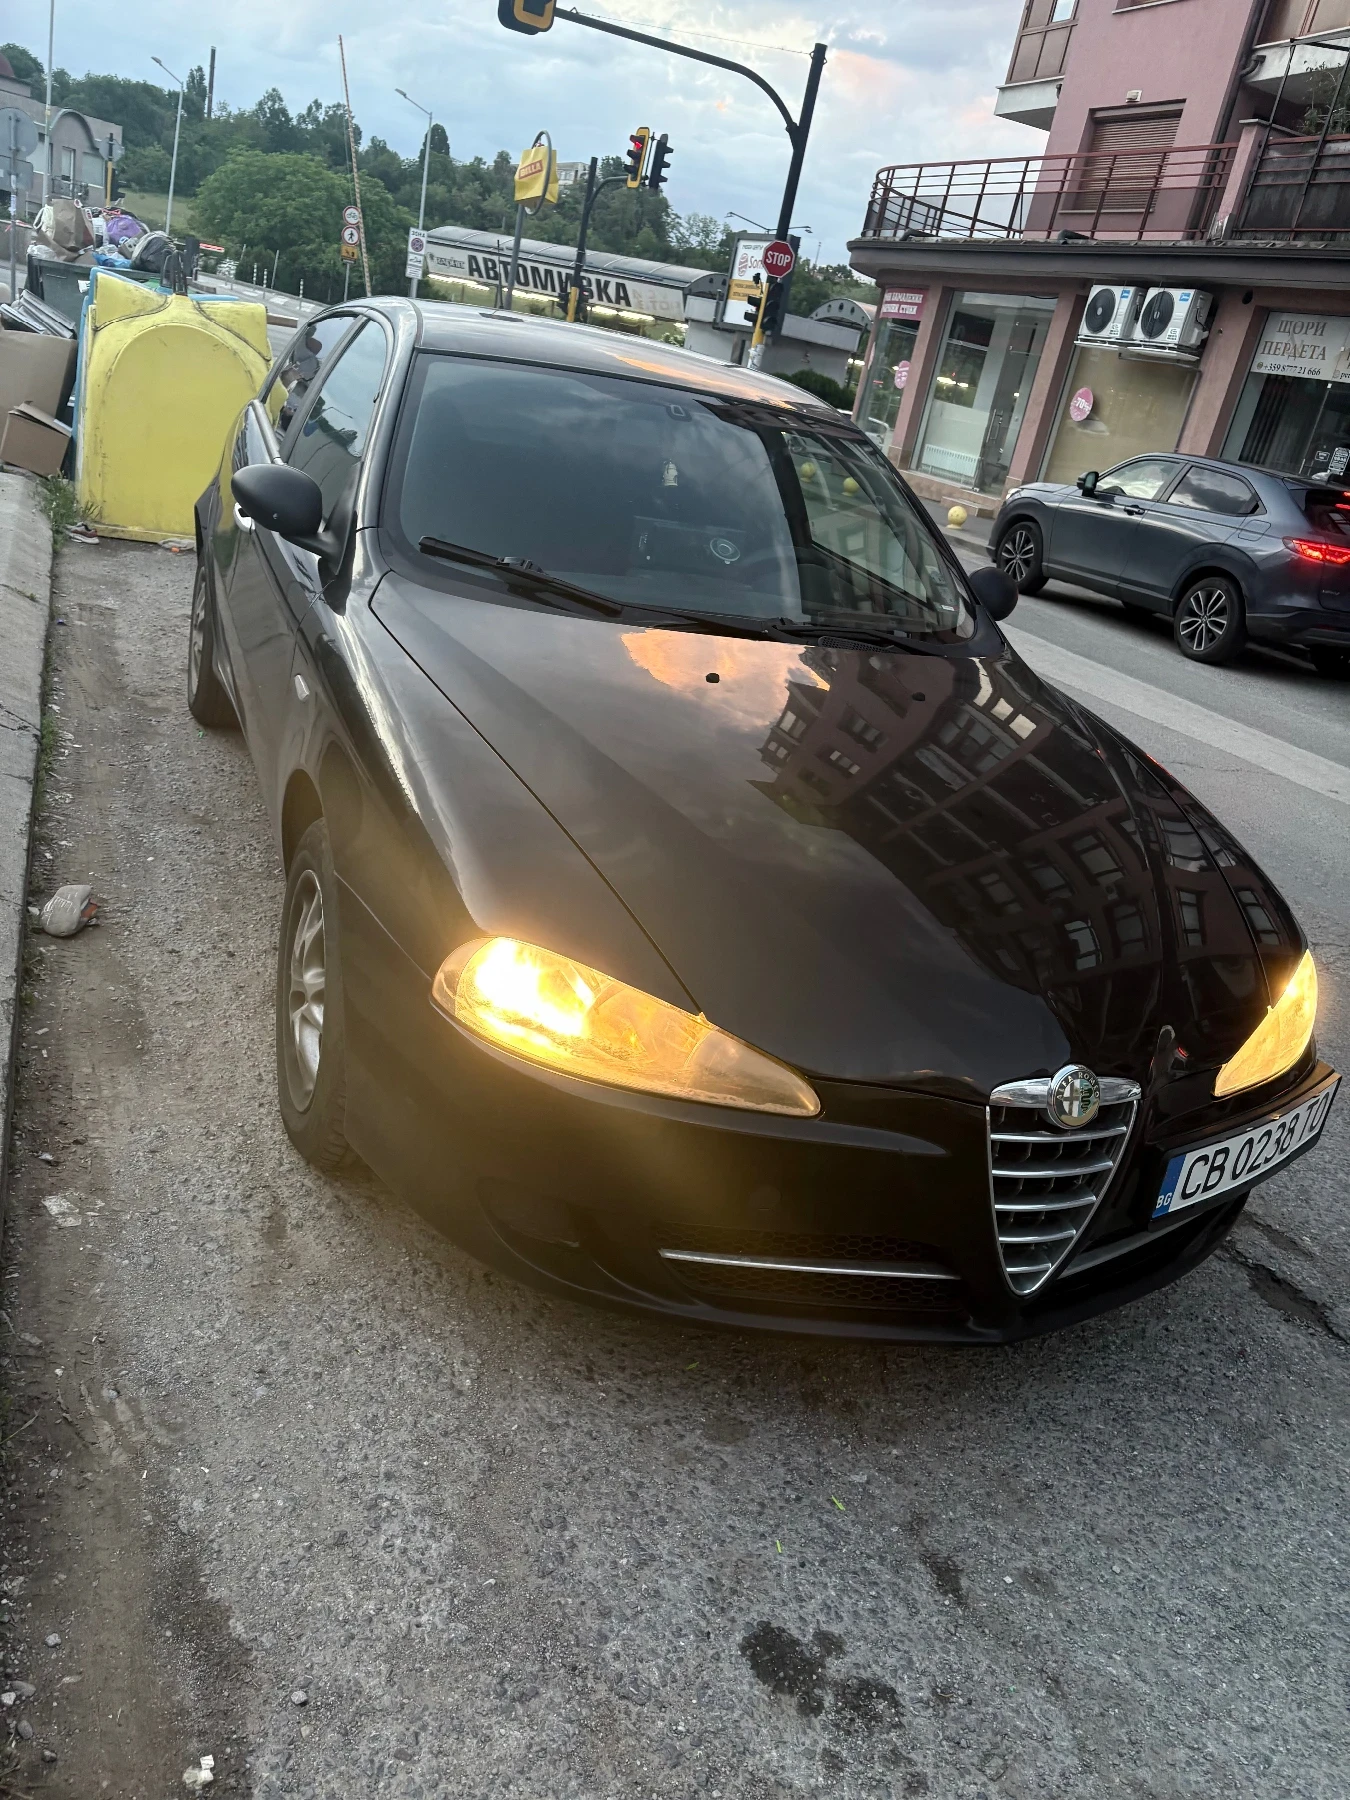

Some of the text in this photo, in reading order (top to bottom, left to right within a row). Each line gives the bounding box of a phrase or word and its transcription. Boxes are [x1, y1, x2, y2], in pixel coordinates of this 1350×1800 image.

[766, 251, 791, 267] STOP
[467, 254, 632, 308] АВТОМИВКА
[1276, 320, 1327, 336] ЩОРИ
[1260, 340, 1326, 361] ПЕРДЕТА
[1264, 363, 1280, 371] +359
[1297, 366, 1307, 374] 21
[1307, 367, 1321, 375] 666
[1057, 1071, 1099, 1099] ALFA ROMEO
[1180, 1146, 1230, 1200] CB
[1231, 1112, 1300, 1180] 0238
[1156, 1192, 1172, 1209] BG
